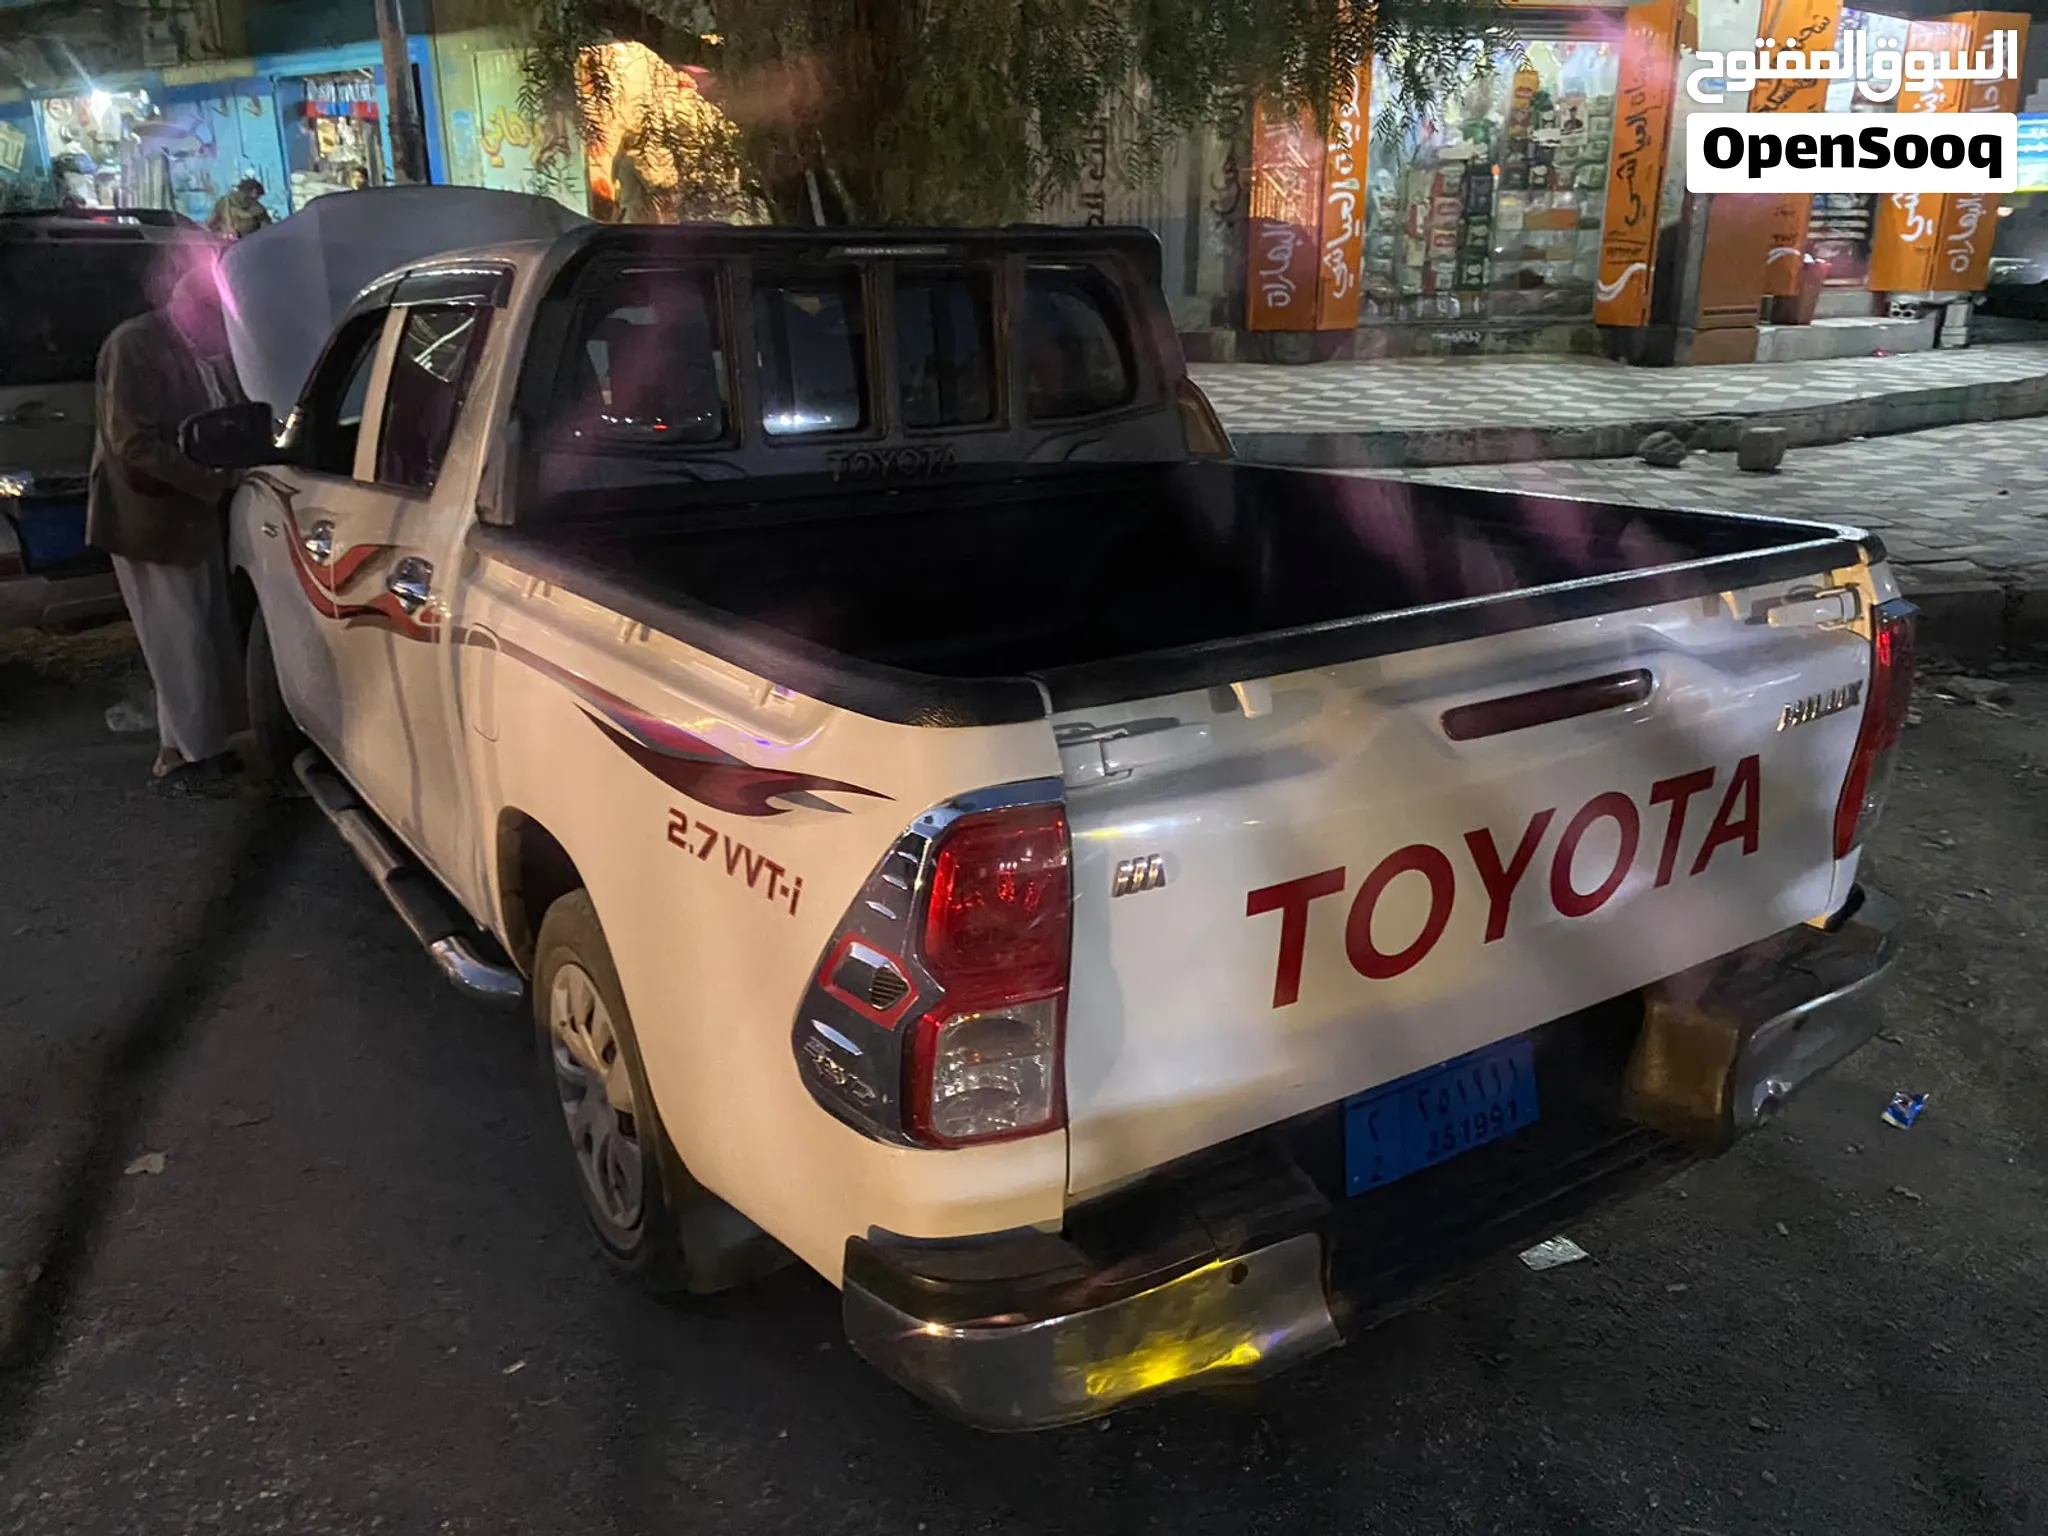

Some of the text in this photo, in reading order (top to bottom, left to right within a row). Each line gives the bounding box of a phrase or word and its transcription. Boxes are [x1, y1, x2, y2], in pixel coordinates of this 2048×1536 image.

[826, 443, 960, 483] TOYOTA
[667, 806, 719, 861] 2.7
[1245, 754, 1762, 1010] TOYOTA
[1425, 1099, 1519, 1159] 251991
